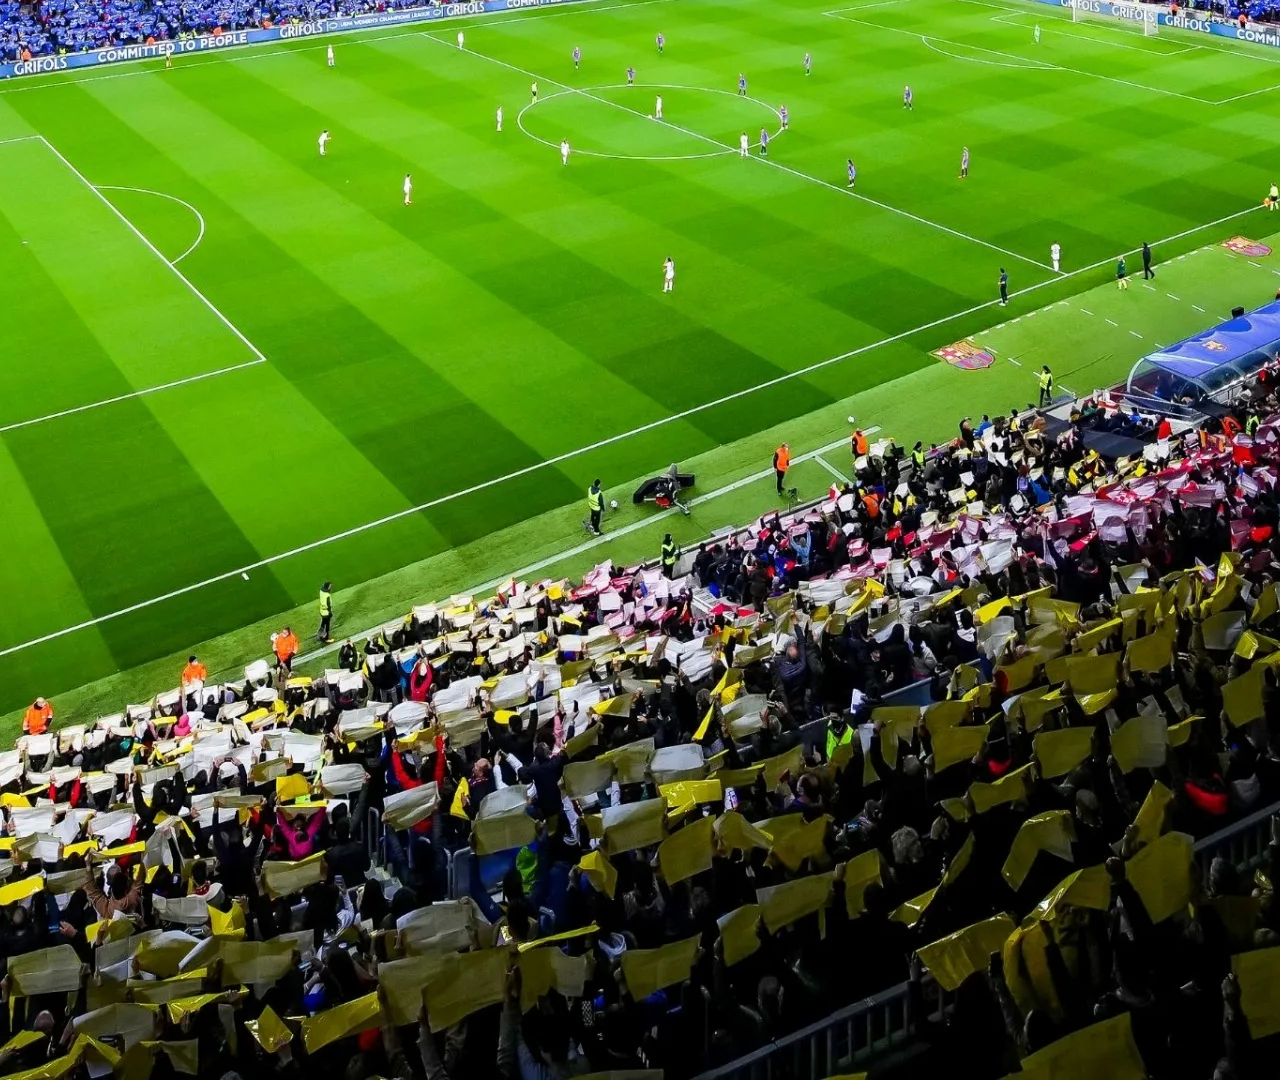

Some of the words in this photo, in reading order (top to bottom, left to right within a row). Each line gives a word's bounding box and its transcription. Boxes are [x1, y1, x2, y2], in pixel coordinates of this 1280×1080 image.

[447, 3, 485, 16] GRIFOLS
[280, 22, 323, 38] GRIFOLS
[1165, 15, 1211, 33] GRIFOLS
[98, 42, 176, 63] COMMITTED
[179, 39, 196, 52] TO
[200, 32, 248, 49] PEOPLE
[14, 57, 67, 76] GRIFOLS
